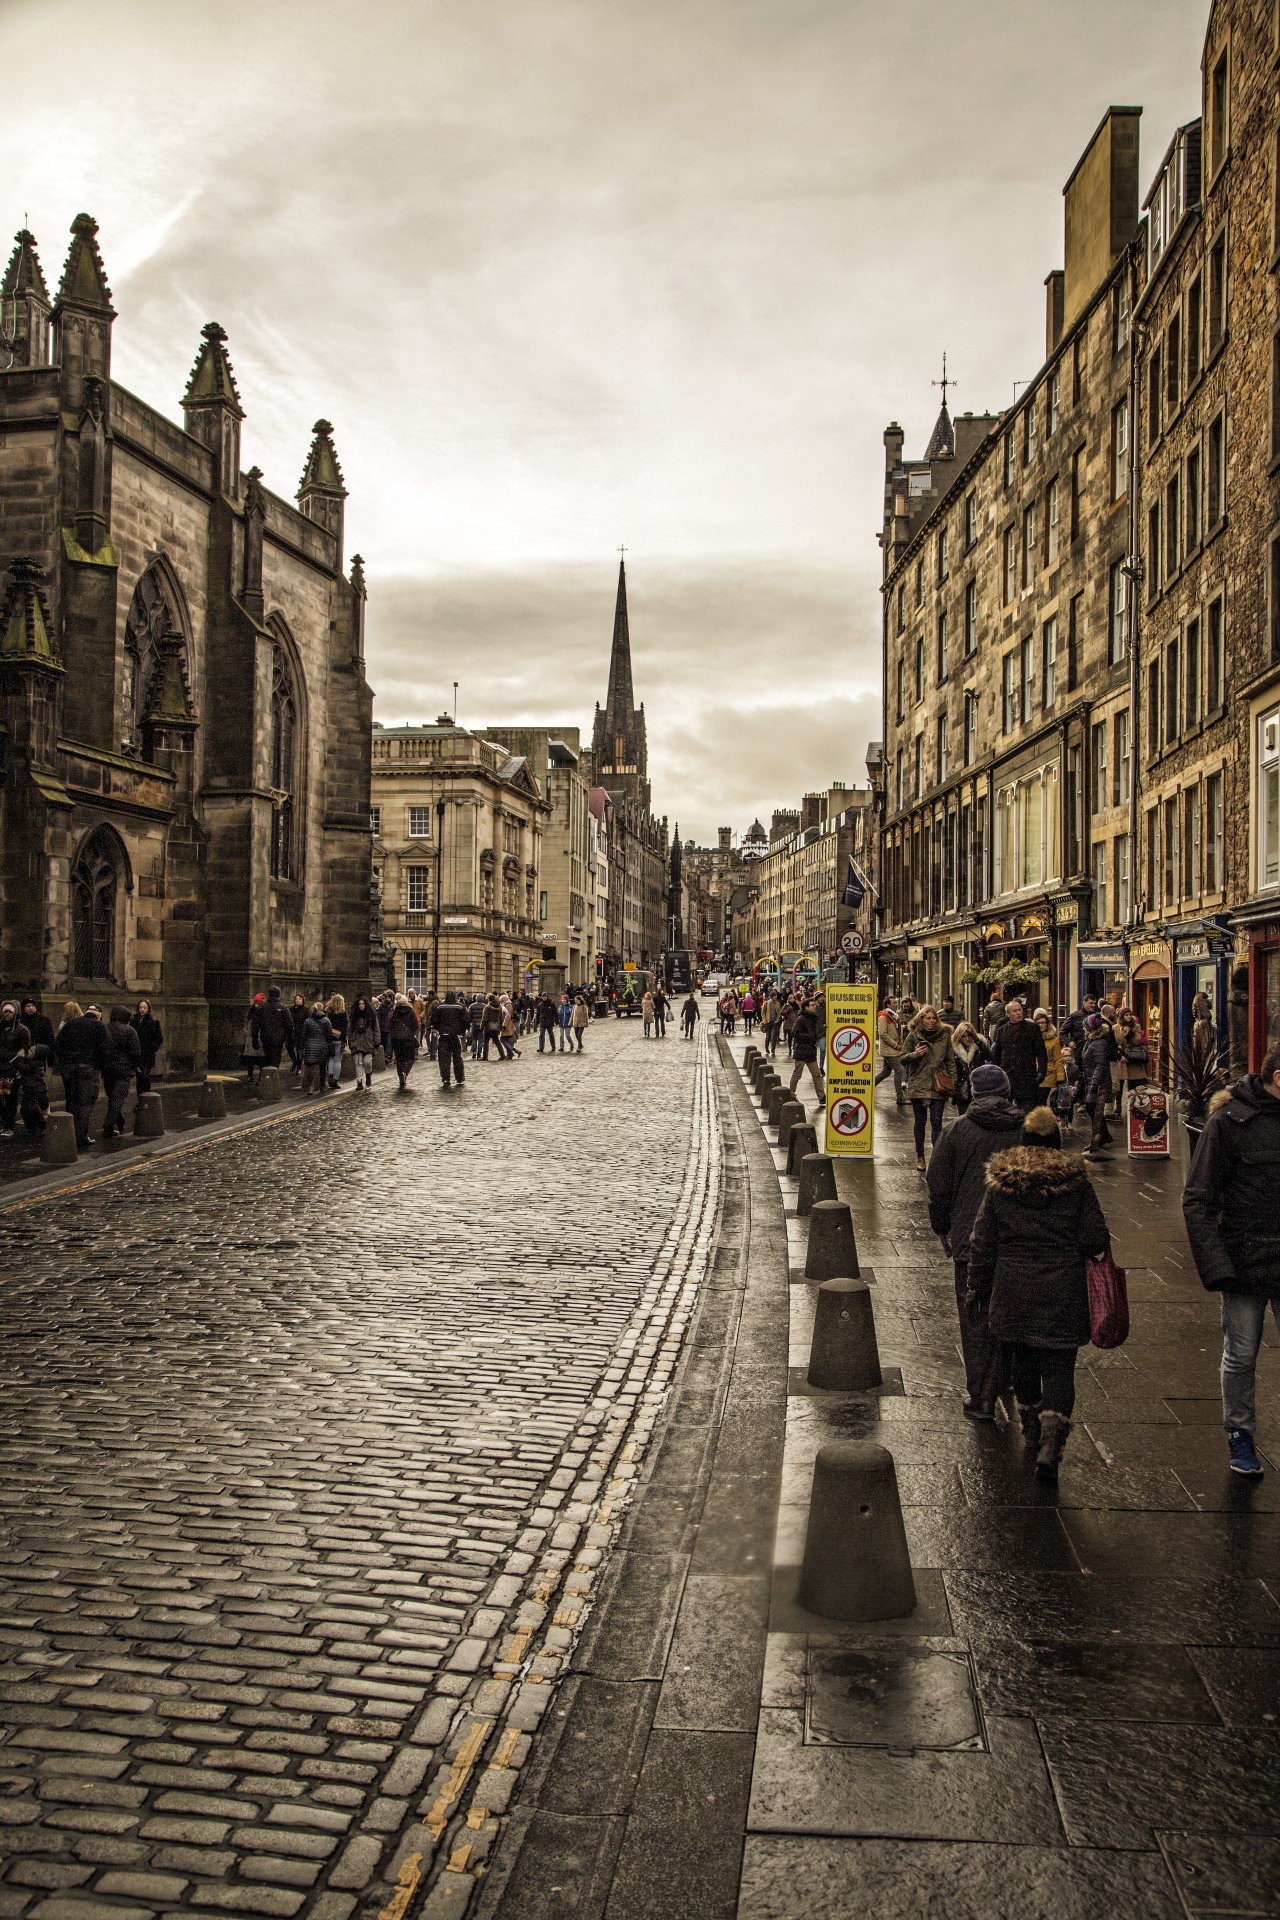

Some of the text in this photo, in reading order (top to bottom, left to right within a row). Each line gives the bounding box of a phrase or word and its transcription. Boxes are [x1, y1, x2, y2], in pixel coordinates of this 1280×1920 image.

[843, 937, 861, 947] 20
[830, 993, 873, 1002] BUSKERS
[828, 1078, 871, 1086] AMPLIFICATION
